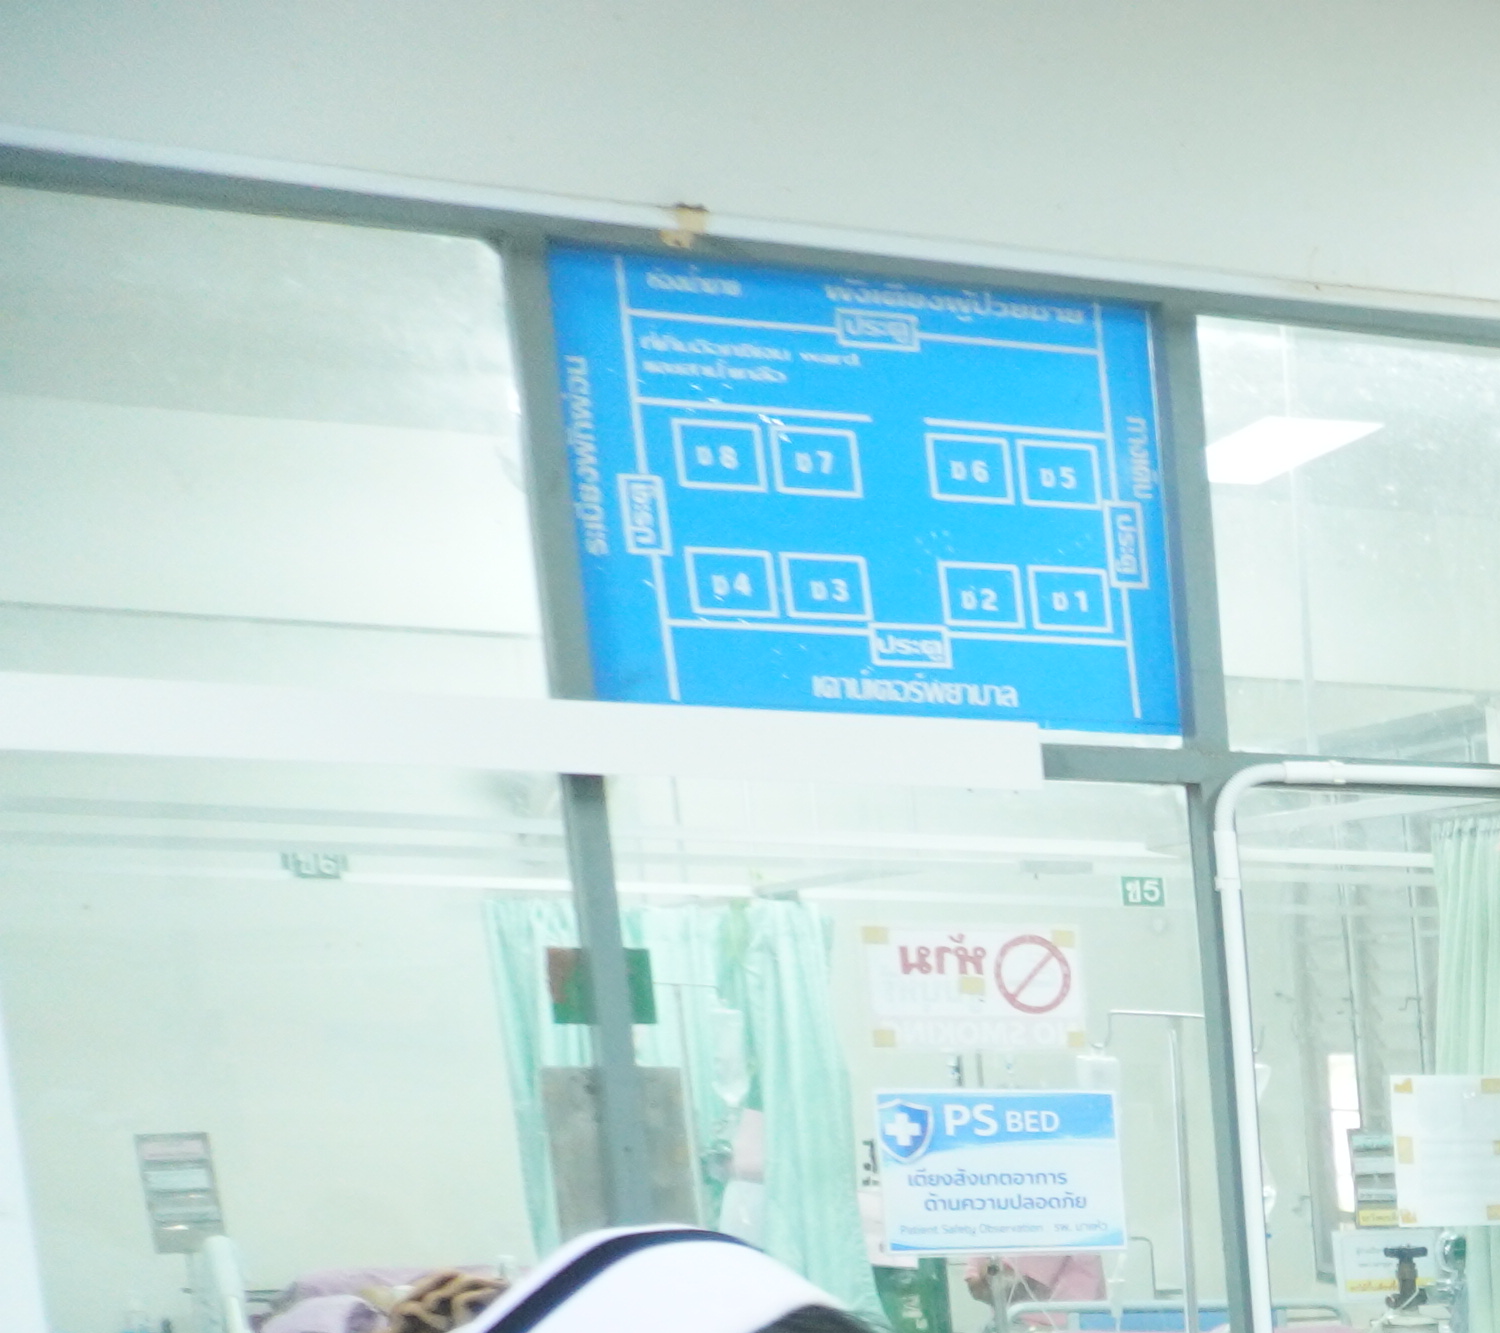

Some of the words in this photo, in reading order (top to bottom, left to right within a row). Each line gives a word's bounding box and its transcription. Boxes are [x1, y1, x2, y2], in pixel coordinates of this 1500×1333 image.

[943, 1104, 999, 1137] PS
[1005, 1111, 1060, 1133] BED
[908, 1167, 1068, 1187] เตียงสังเกตอาการ
[924, 1193, 1087, 1212] ด้านความปลอดภัย
